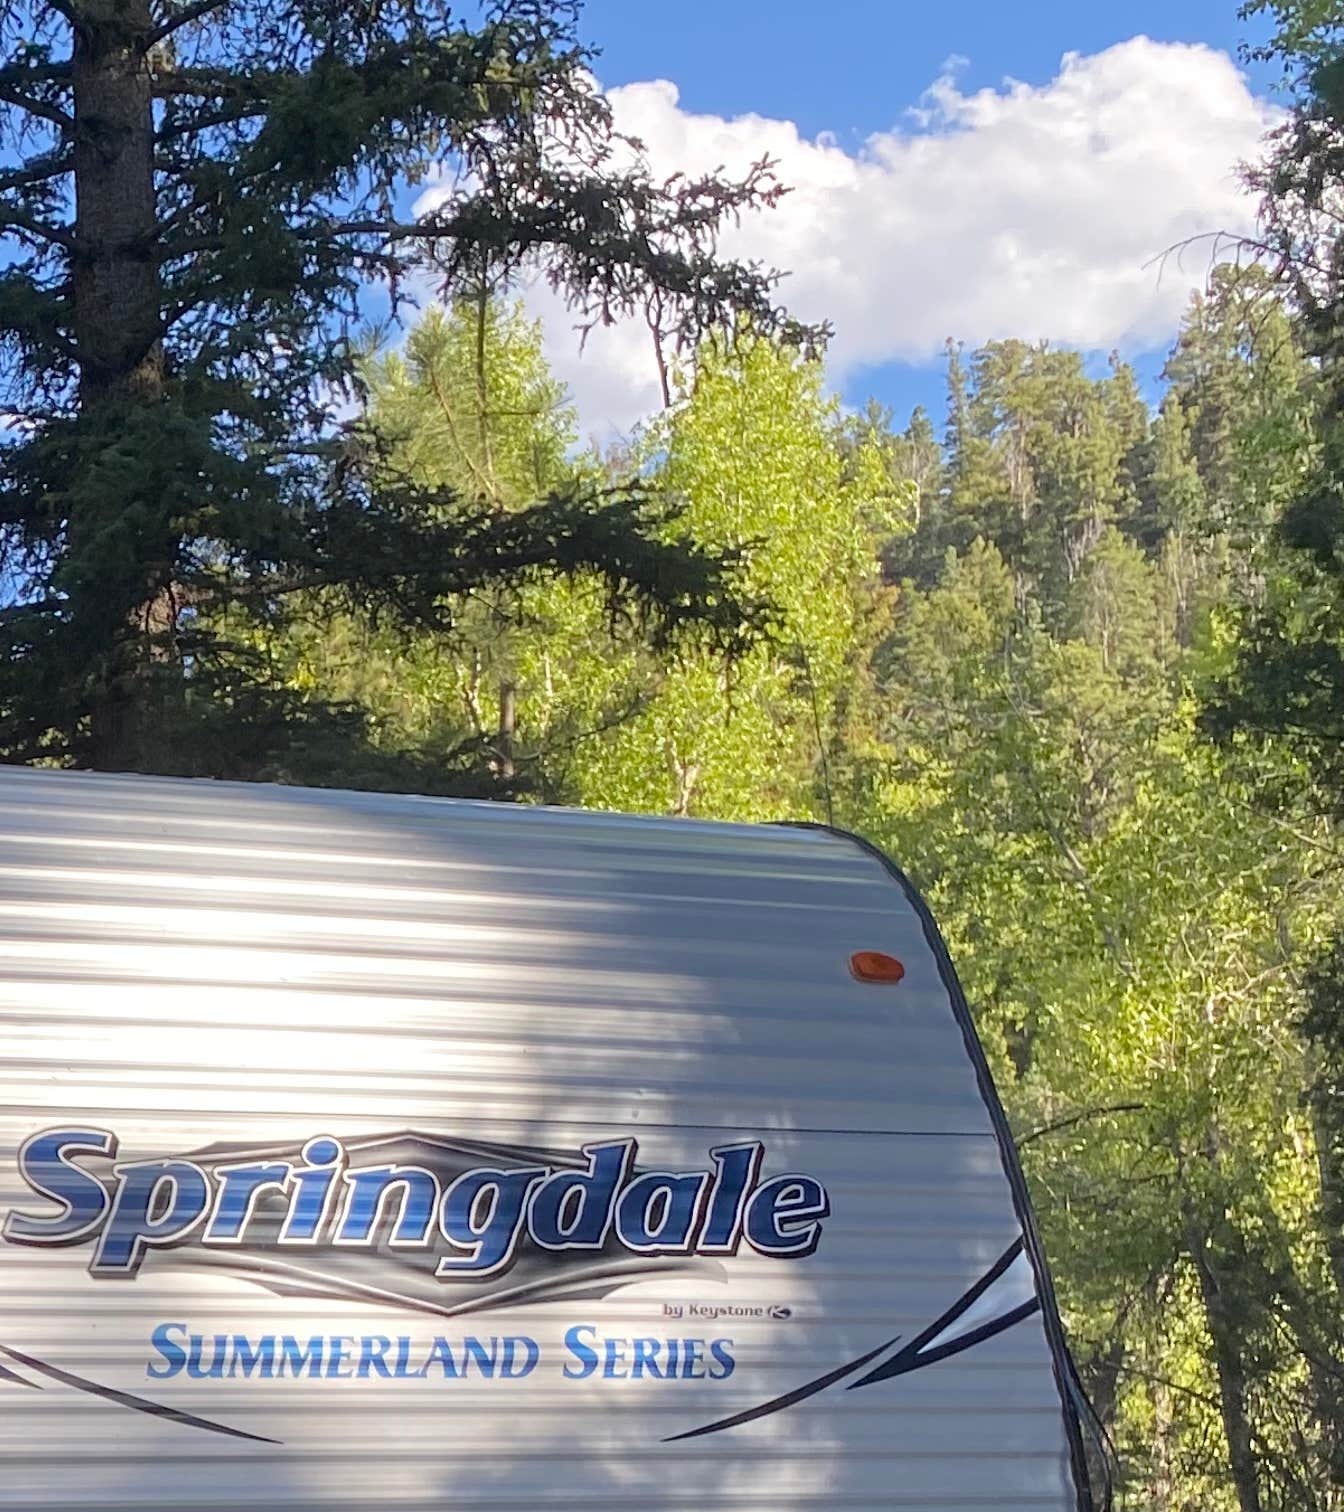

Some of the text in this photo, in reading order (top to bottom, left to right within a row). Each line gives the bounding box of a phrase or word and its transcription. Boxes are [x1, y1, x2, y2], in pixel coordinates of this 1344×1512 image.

[2, 1126, 831, 1282] Springdale
[664, 1304, 763, 1319] by Keystone
[147, 1322, 736, 1380] SUMMERLAND SERIES
